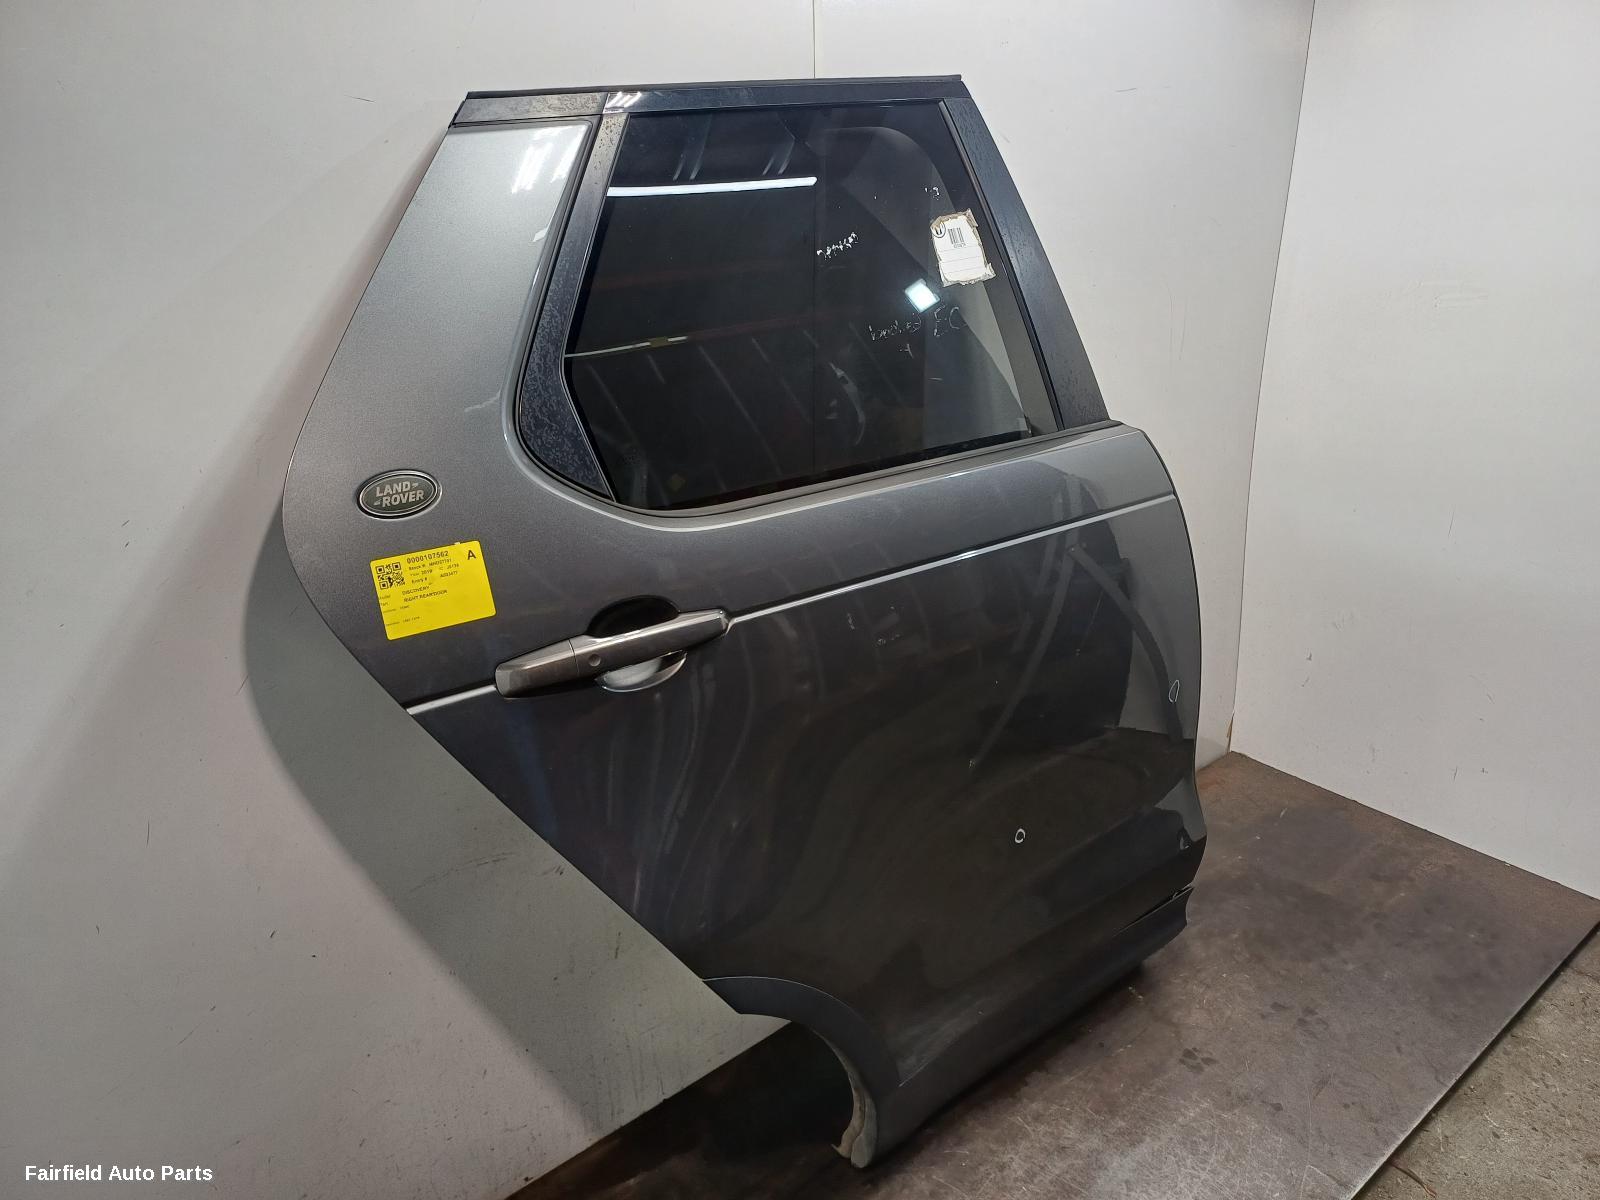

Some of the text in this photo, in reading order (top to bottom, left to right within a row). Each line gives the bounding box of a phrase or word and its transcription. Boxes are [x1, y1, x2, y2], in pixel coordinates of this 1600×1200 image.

[375, 481, 411, 498] LAND
[382, 489, 425, 508] ROVER
[466, 549, 477, 561] A
